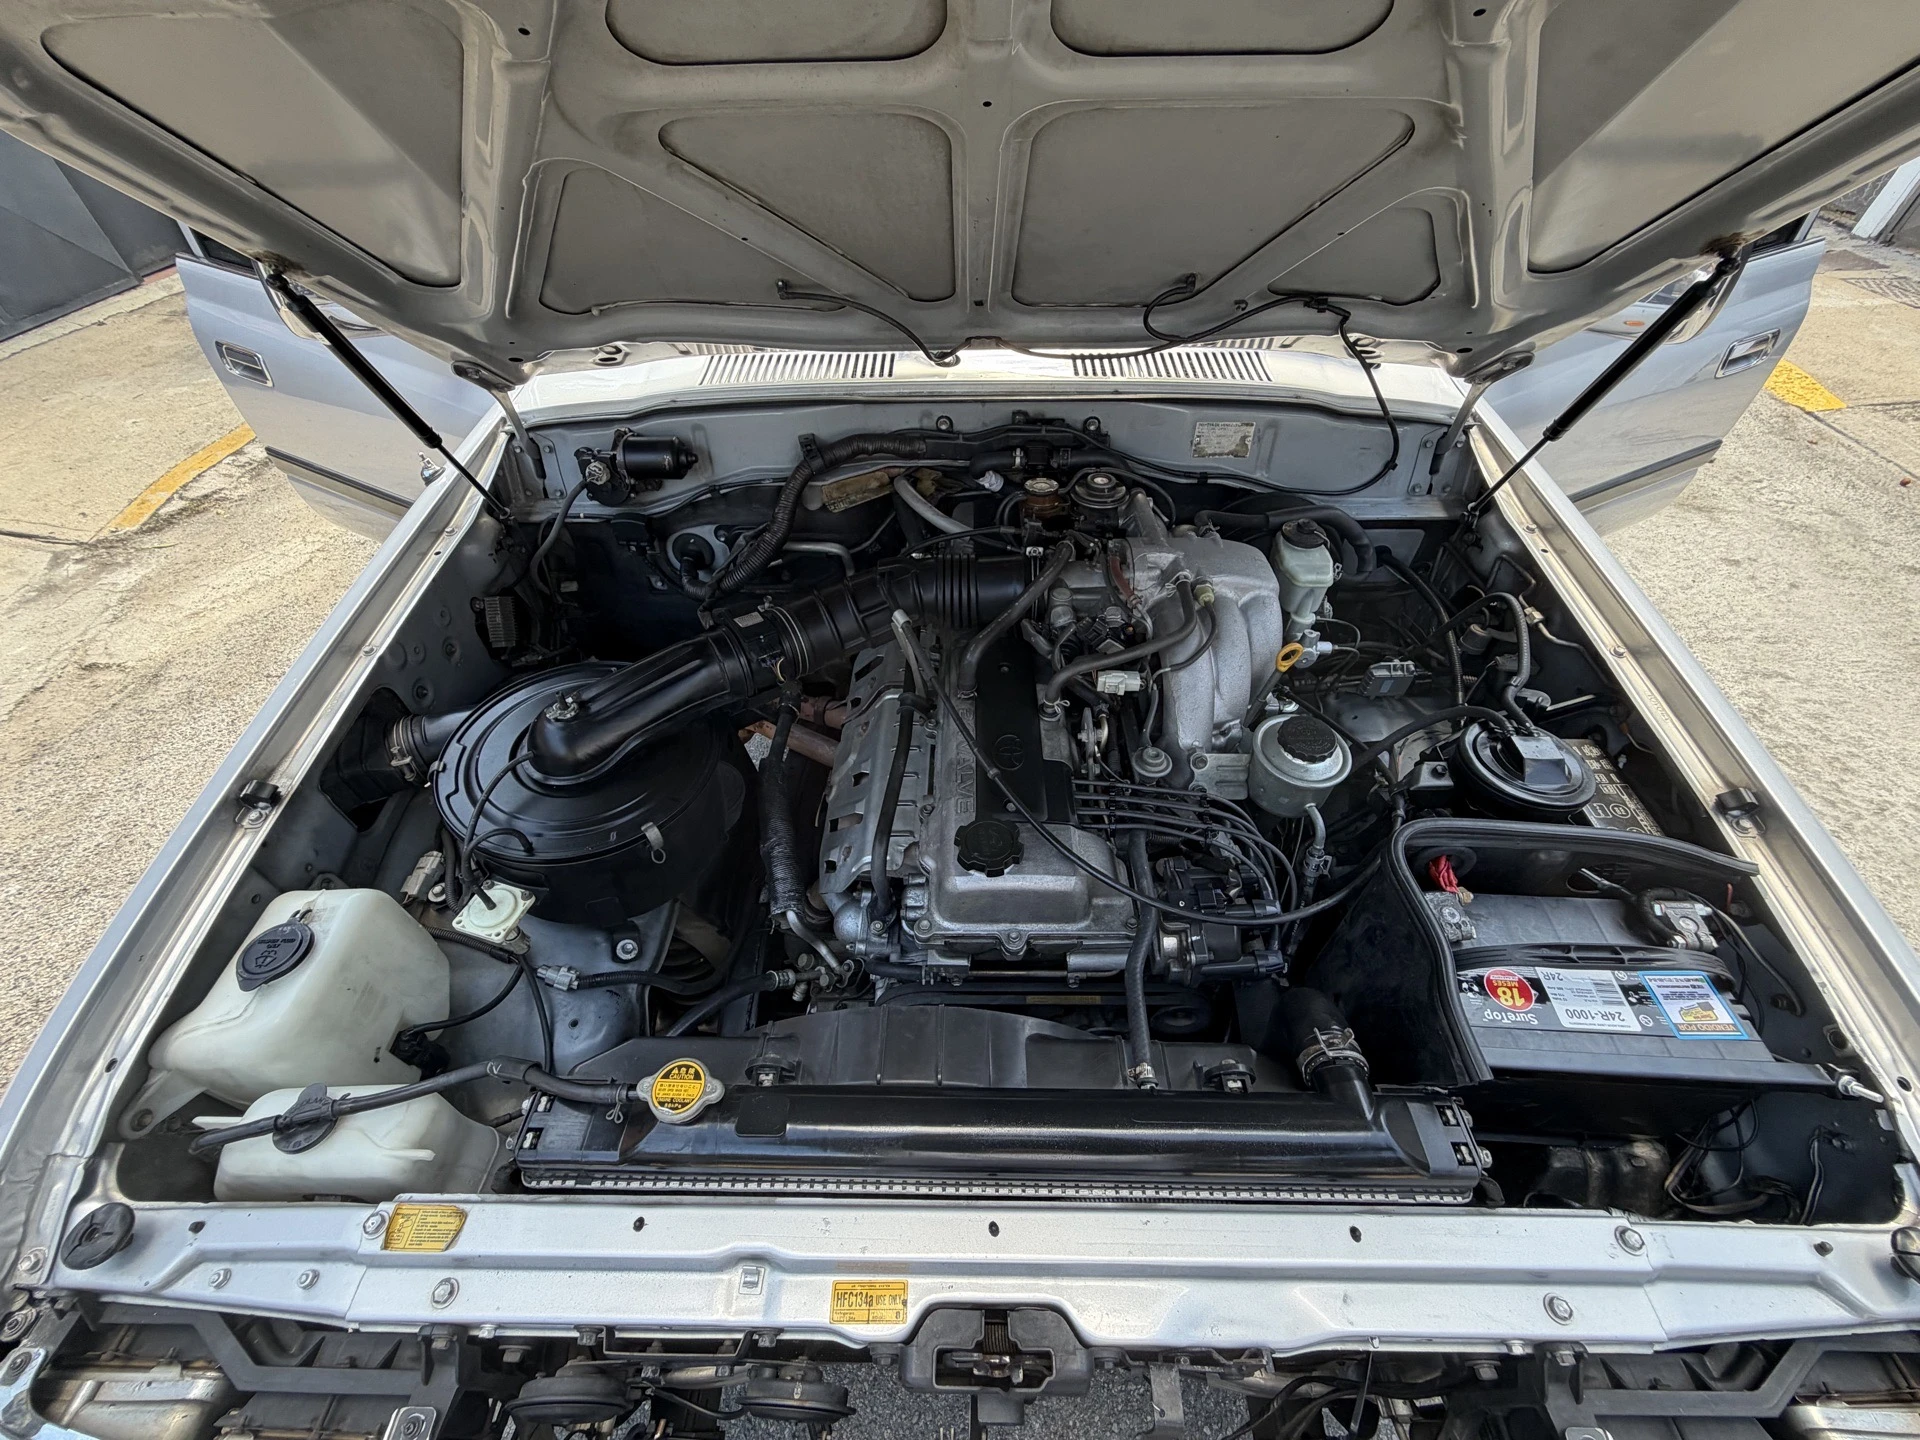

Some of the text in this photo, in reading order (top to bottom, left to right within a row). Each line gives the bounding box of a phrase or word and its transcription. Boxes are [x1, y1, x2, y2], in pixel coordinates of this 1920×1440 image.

[1541, 971, 1563, 981] 24R
[1492, 980, 1518, 988] MESES
[1497, 987, 1525, 1006] 18
[1488, 1009, 1538, 1025] SureTop
[1565, 1008, 1626, 1022] 24R-1000
[1677, 1023, 1737, 1031] VENDIDO POR
[835, 1291, 902, 1307] HFC134a USE ONLY
